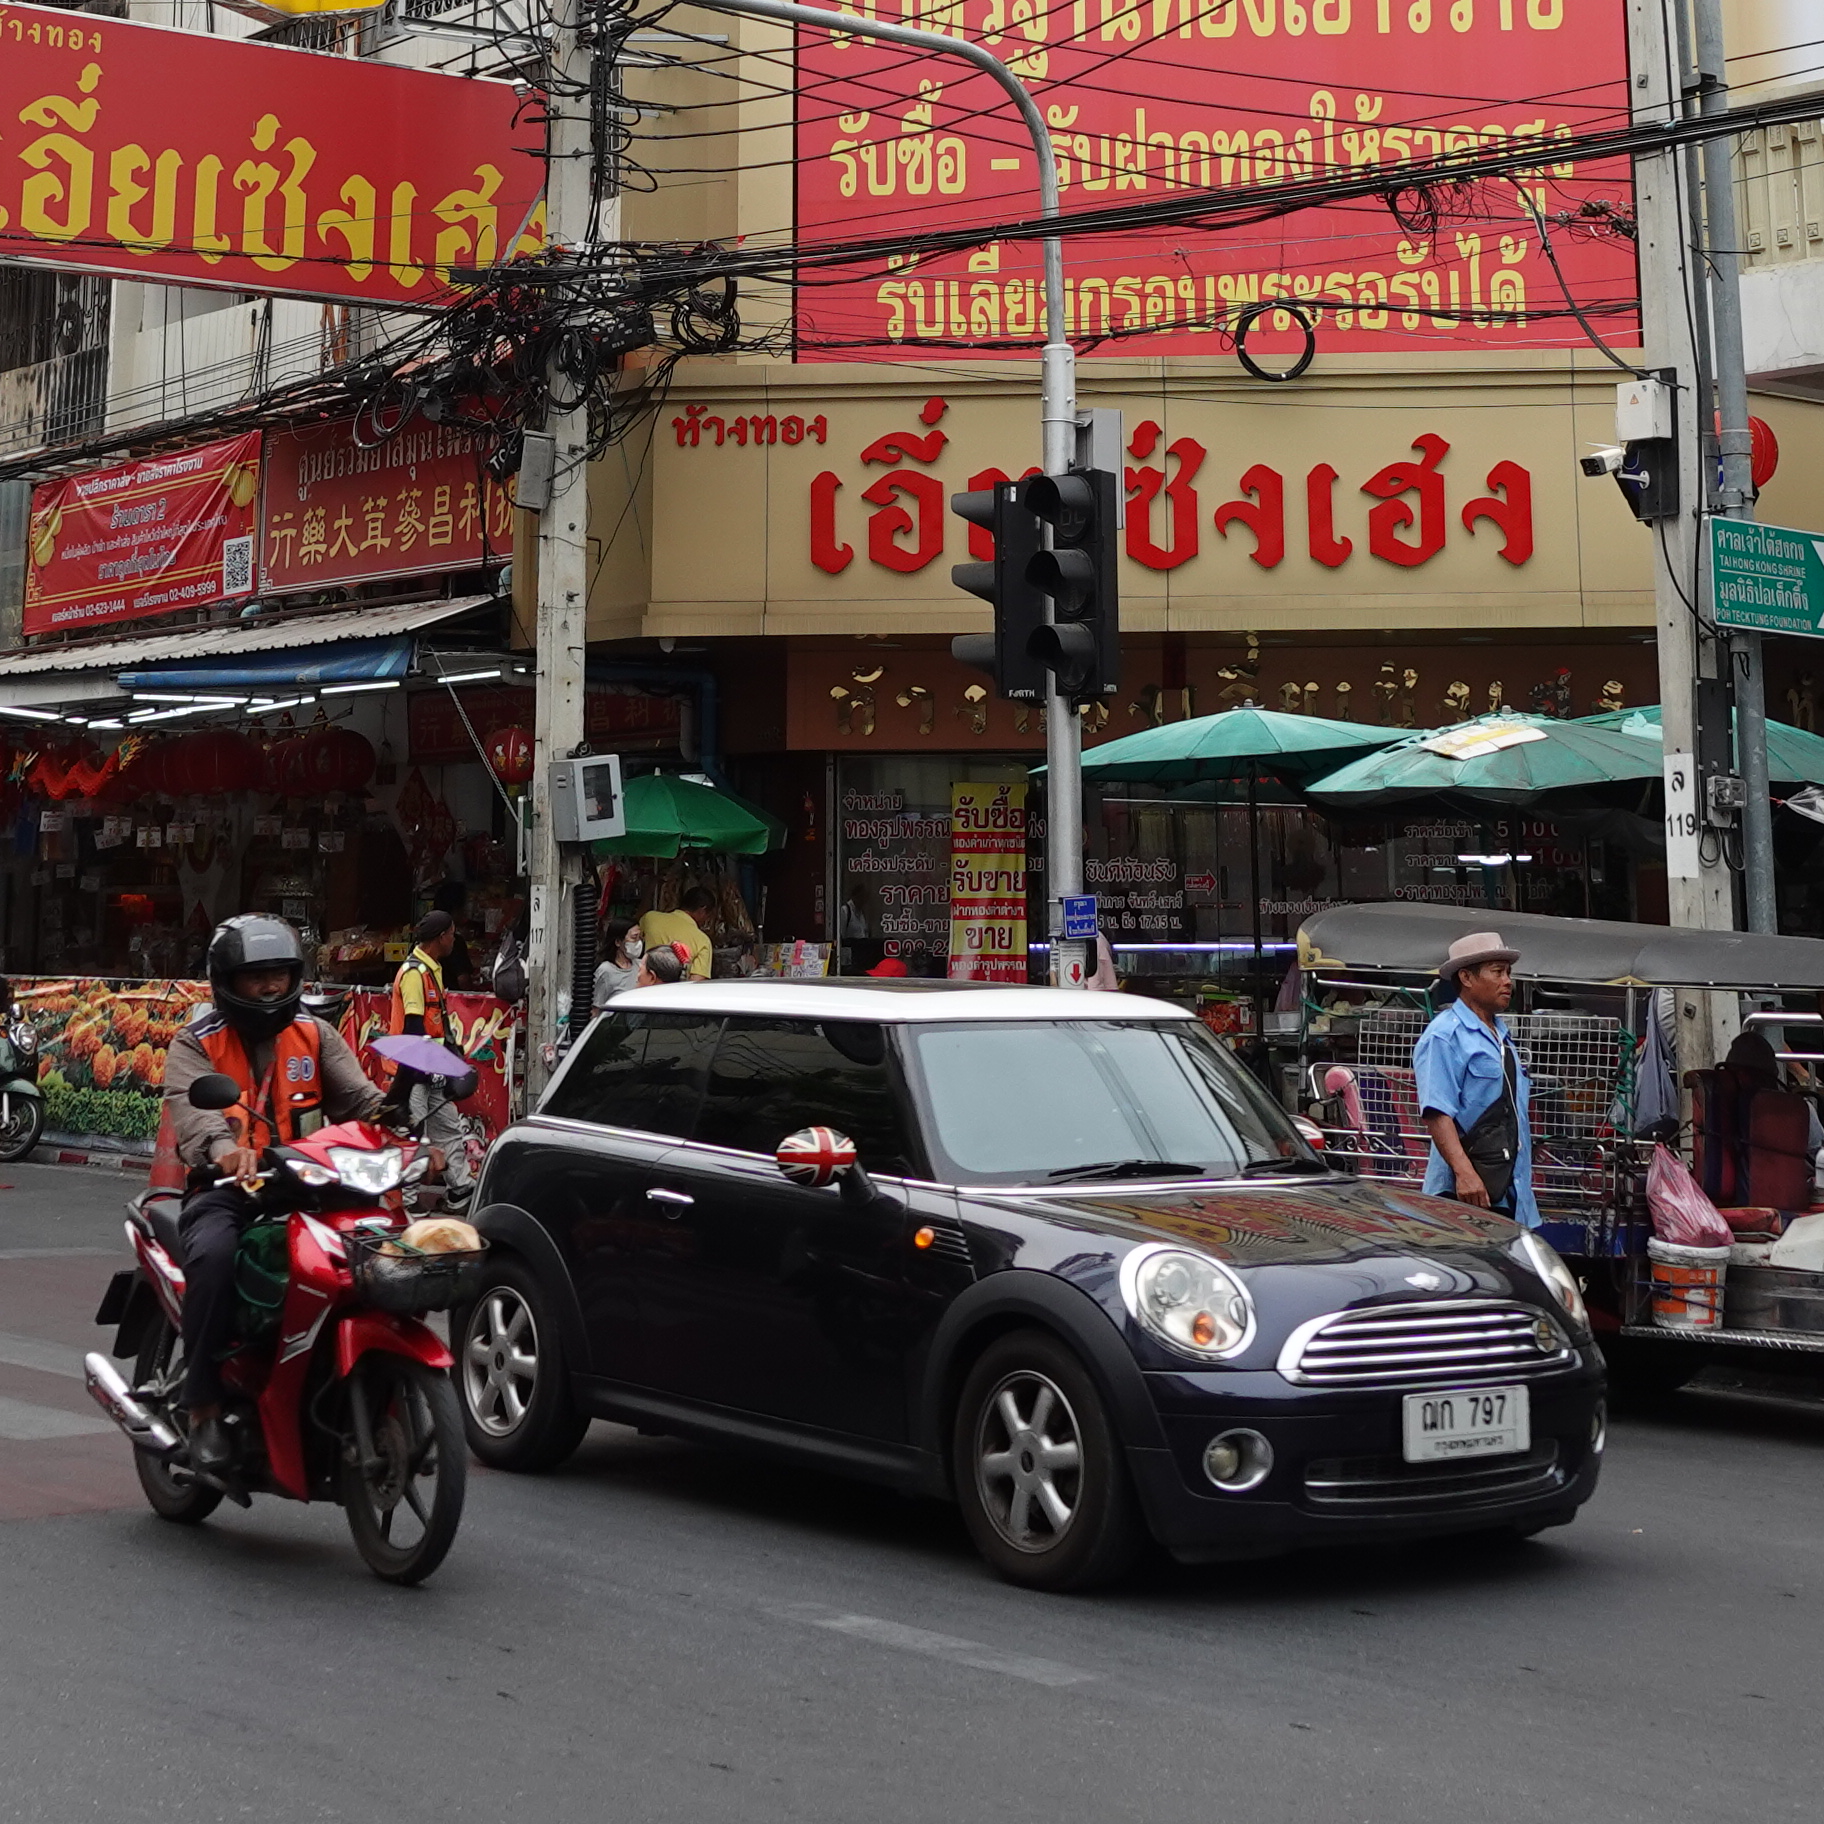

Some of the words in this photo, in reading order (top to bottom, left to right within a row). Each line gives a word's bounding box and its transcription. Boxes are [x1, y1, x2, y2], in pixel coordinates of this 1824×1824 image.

[829, 78, 967, 199] รับซื้อ
[672, 405, 827, 447] ห้างทอง
[1717, 527, 1805, 562] ศาลเจ้าไต้ฮงกง
[1719, 554, 1732, 567] TAI
[1732, 557, 1755, 571] HONG
[1756, 560, 1778, 575] KONG
[1778, 563, 1807, 578] SHRINE
[843, 787, 903, 812] จำหน่าย
[954, 786, 1025, 831] รับซื้อ
[1666, 812, 1697, 838] 119
[848, 848, 936, 873] เครื่องประดับ
[1085, 856, 1177, 884] ยินดีต้อนรับ
[1121, 912, 1137, 929] ถึง
[1139, 914, 1168, 930] 17.15
[529, 927, 545, 945] 117
[965, 927, 1014, 951] ขาย
[286, 1056, 315, 1083] 30
[1469, 1394, 1506, 1427] 797
